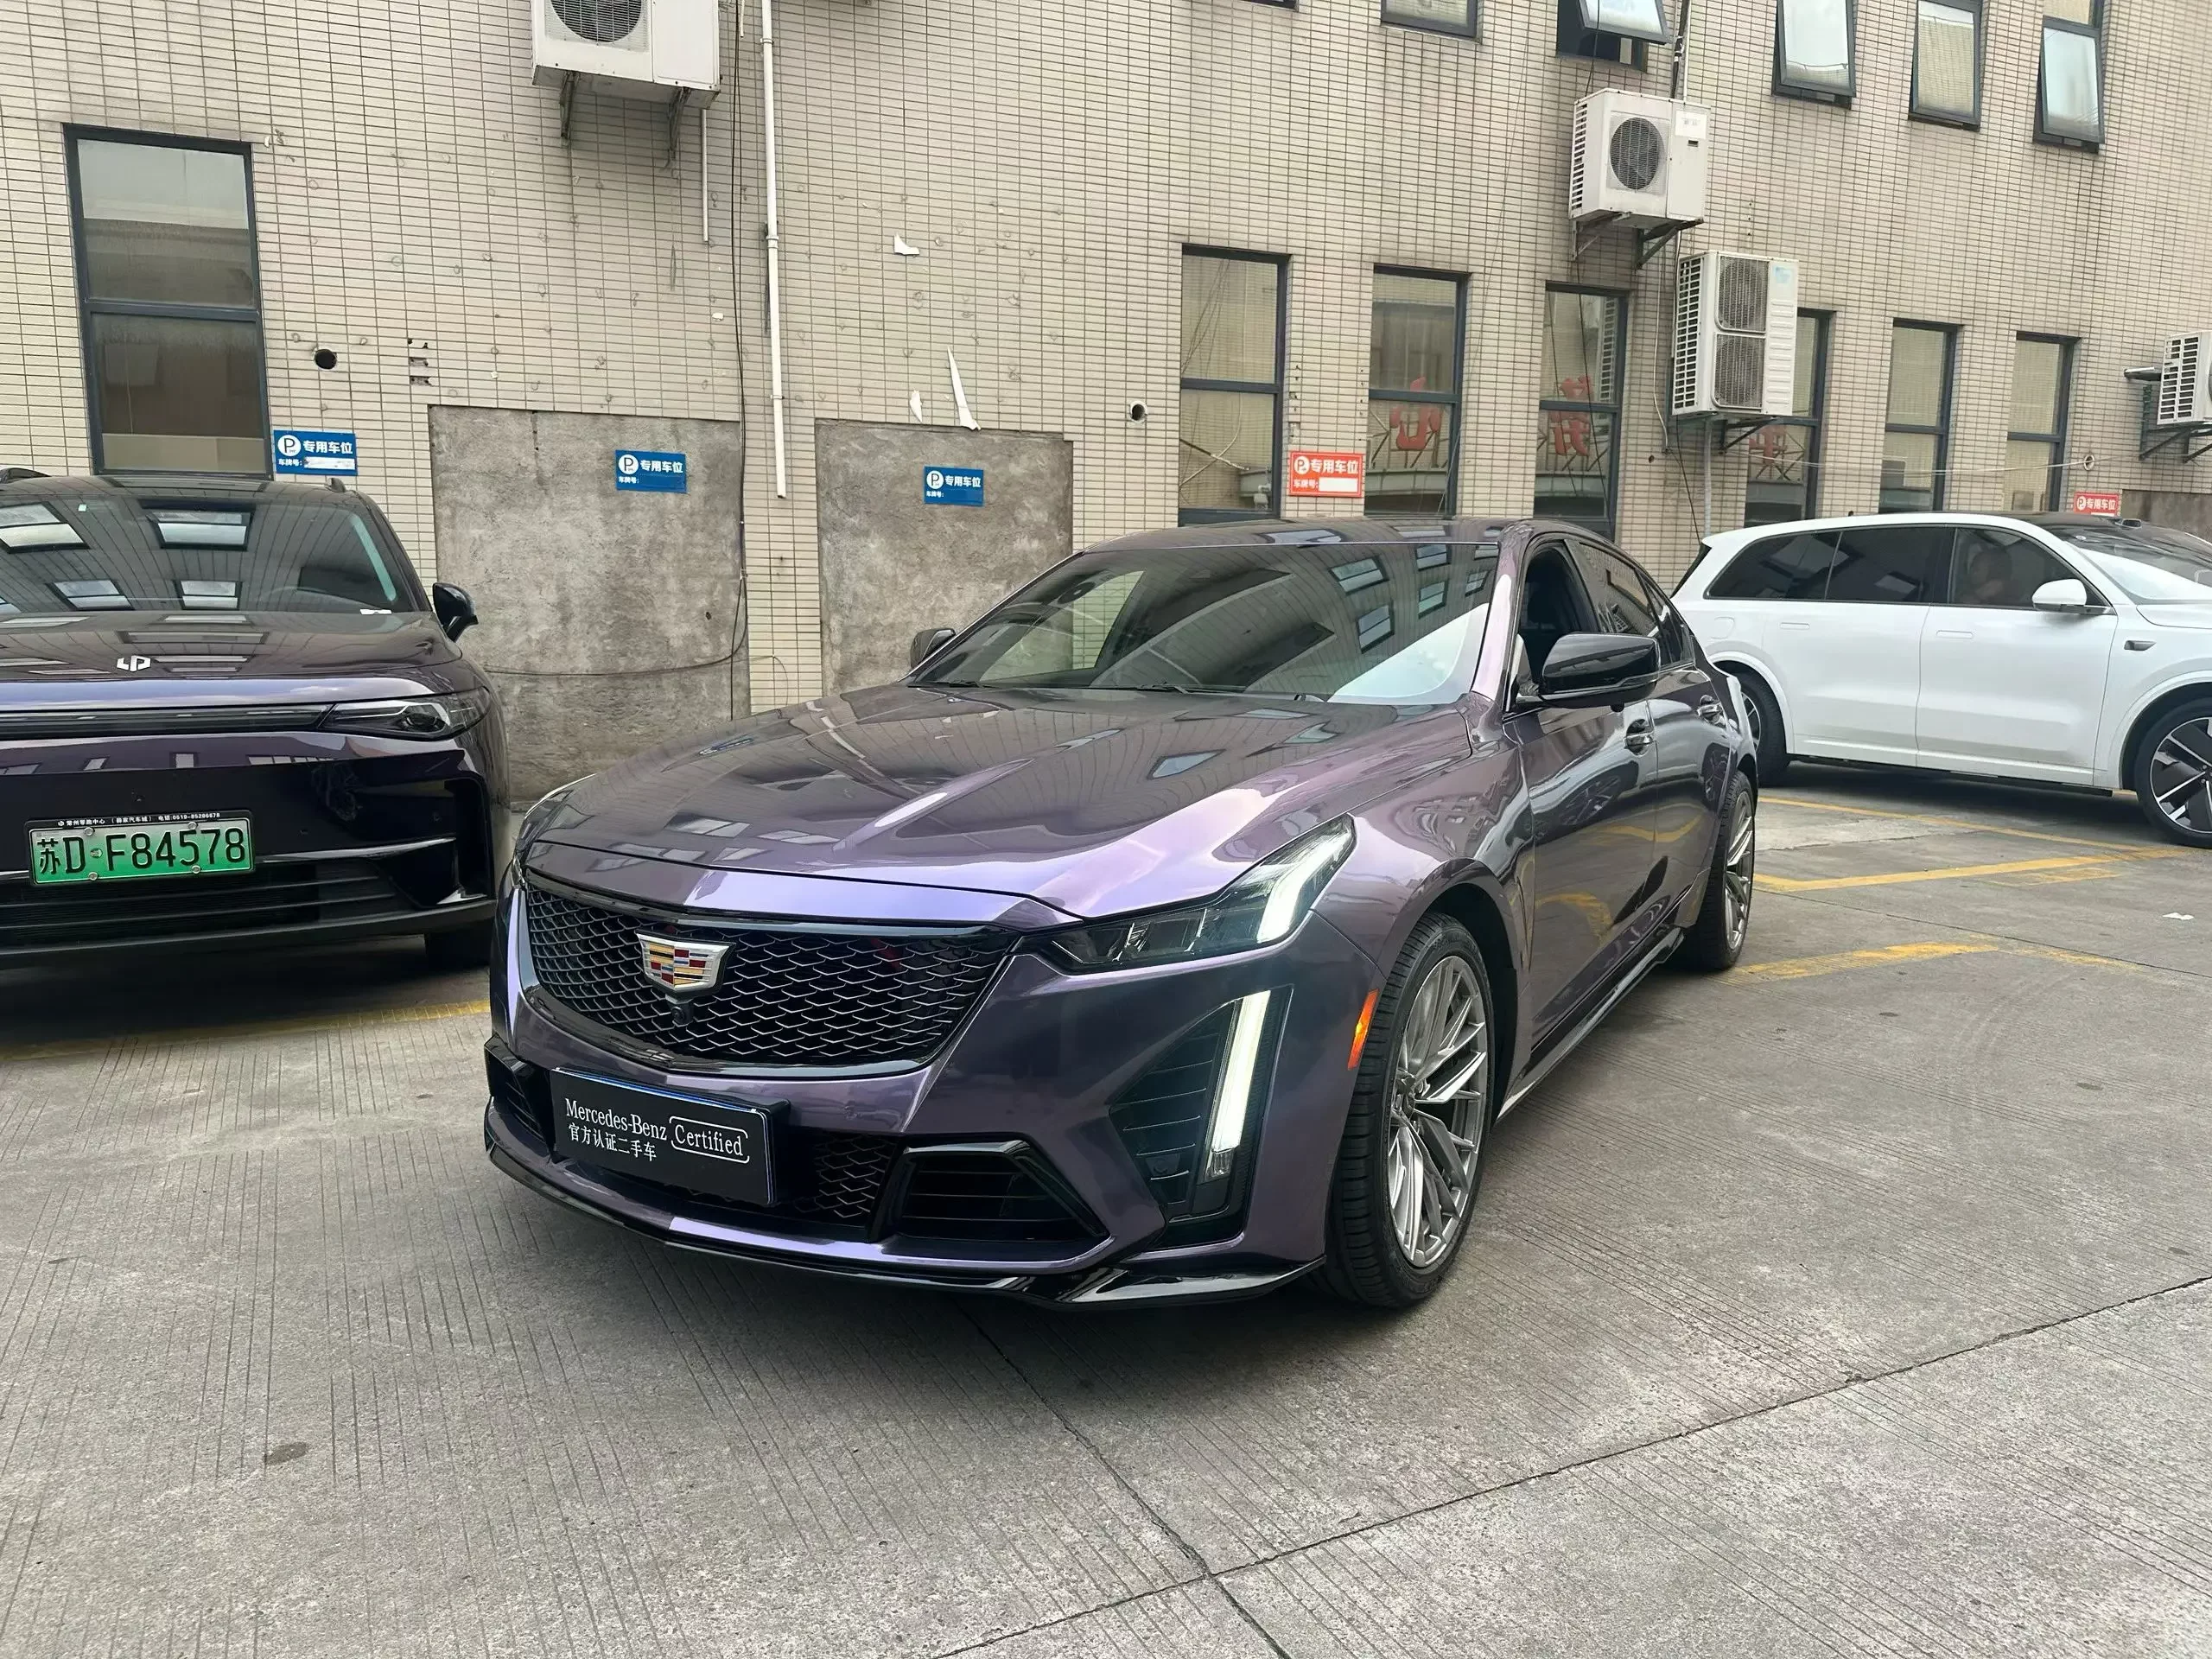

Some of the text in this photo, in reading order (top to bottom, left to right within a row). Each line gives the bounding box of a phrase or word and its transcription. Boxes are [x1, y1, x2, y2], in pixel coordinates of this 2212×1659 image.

[302, 440, 353, 454] 专用车位
[640, 460, 683, 474] 专用车位
[1310, 458, 1359, 474] 专用车位
[944, 475, 982, 488] 专用车位
[2086, 498, 2116, 511] 专用车位
[564, 1097, 744, 1156] Mercedes-Benz Certified
[569, 1122, 657, 1162] 官方认证二手车
